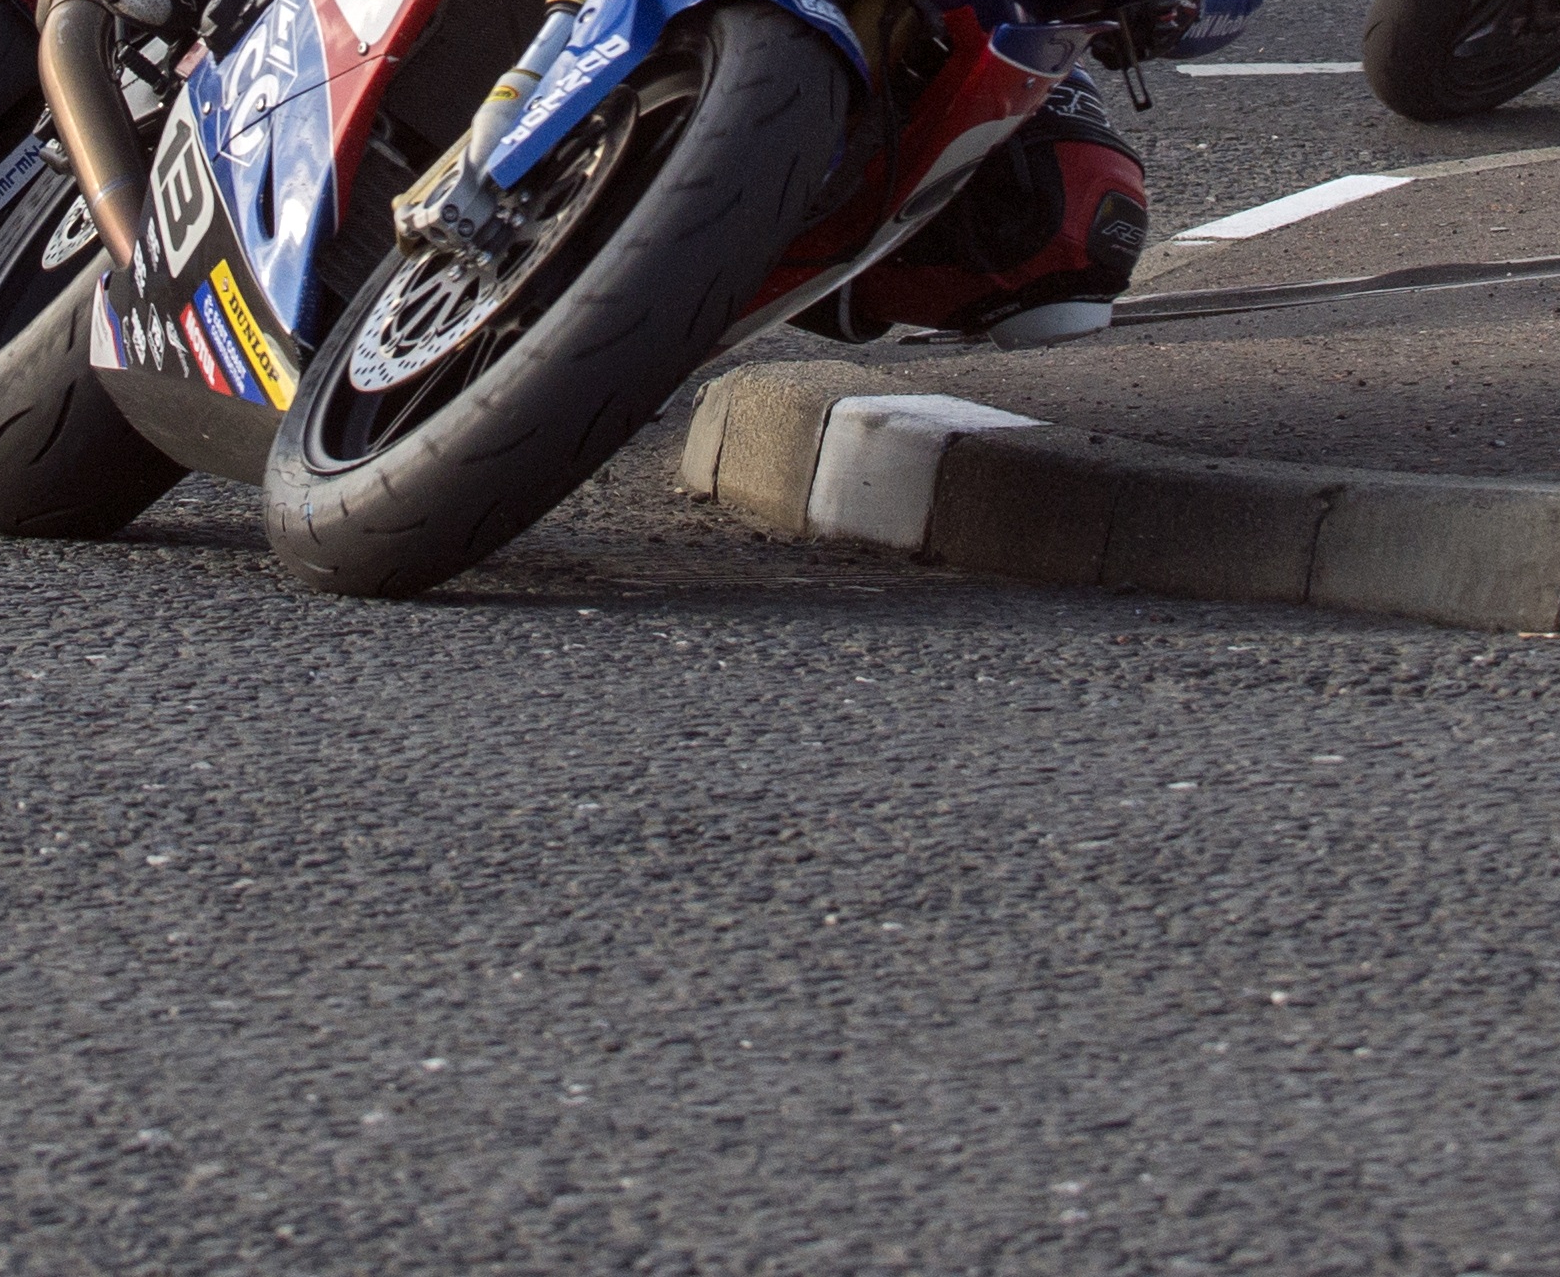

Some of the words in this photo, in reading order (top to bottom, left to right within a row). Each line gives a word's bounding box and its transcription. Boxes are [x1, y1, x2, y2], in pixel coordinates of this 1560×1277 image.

[158, 118, 206, 253] 13
[184, 307, 218, 388] MOTUL
[228, 283, 280, 383] DUNLOP
